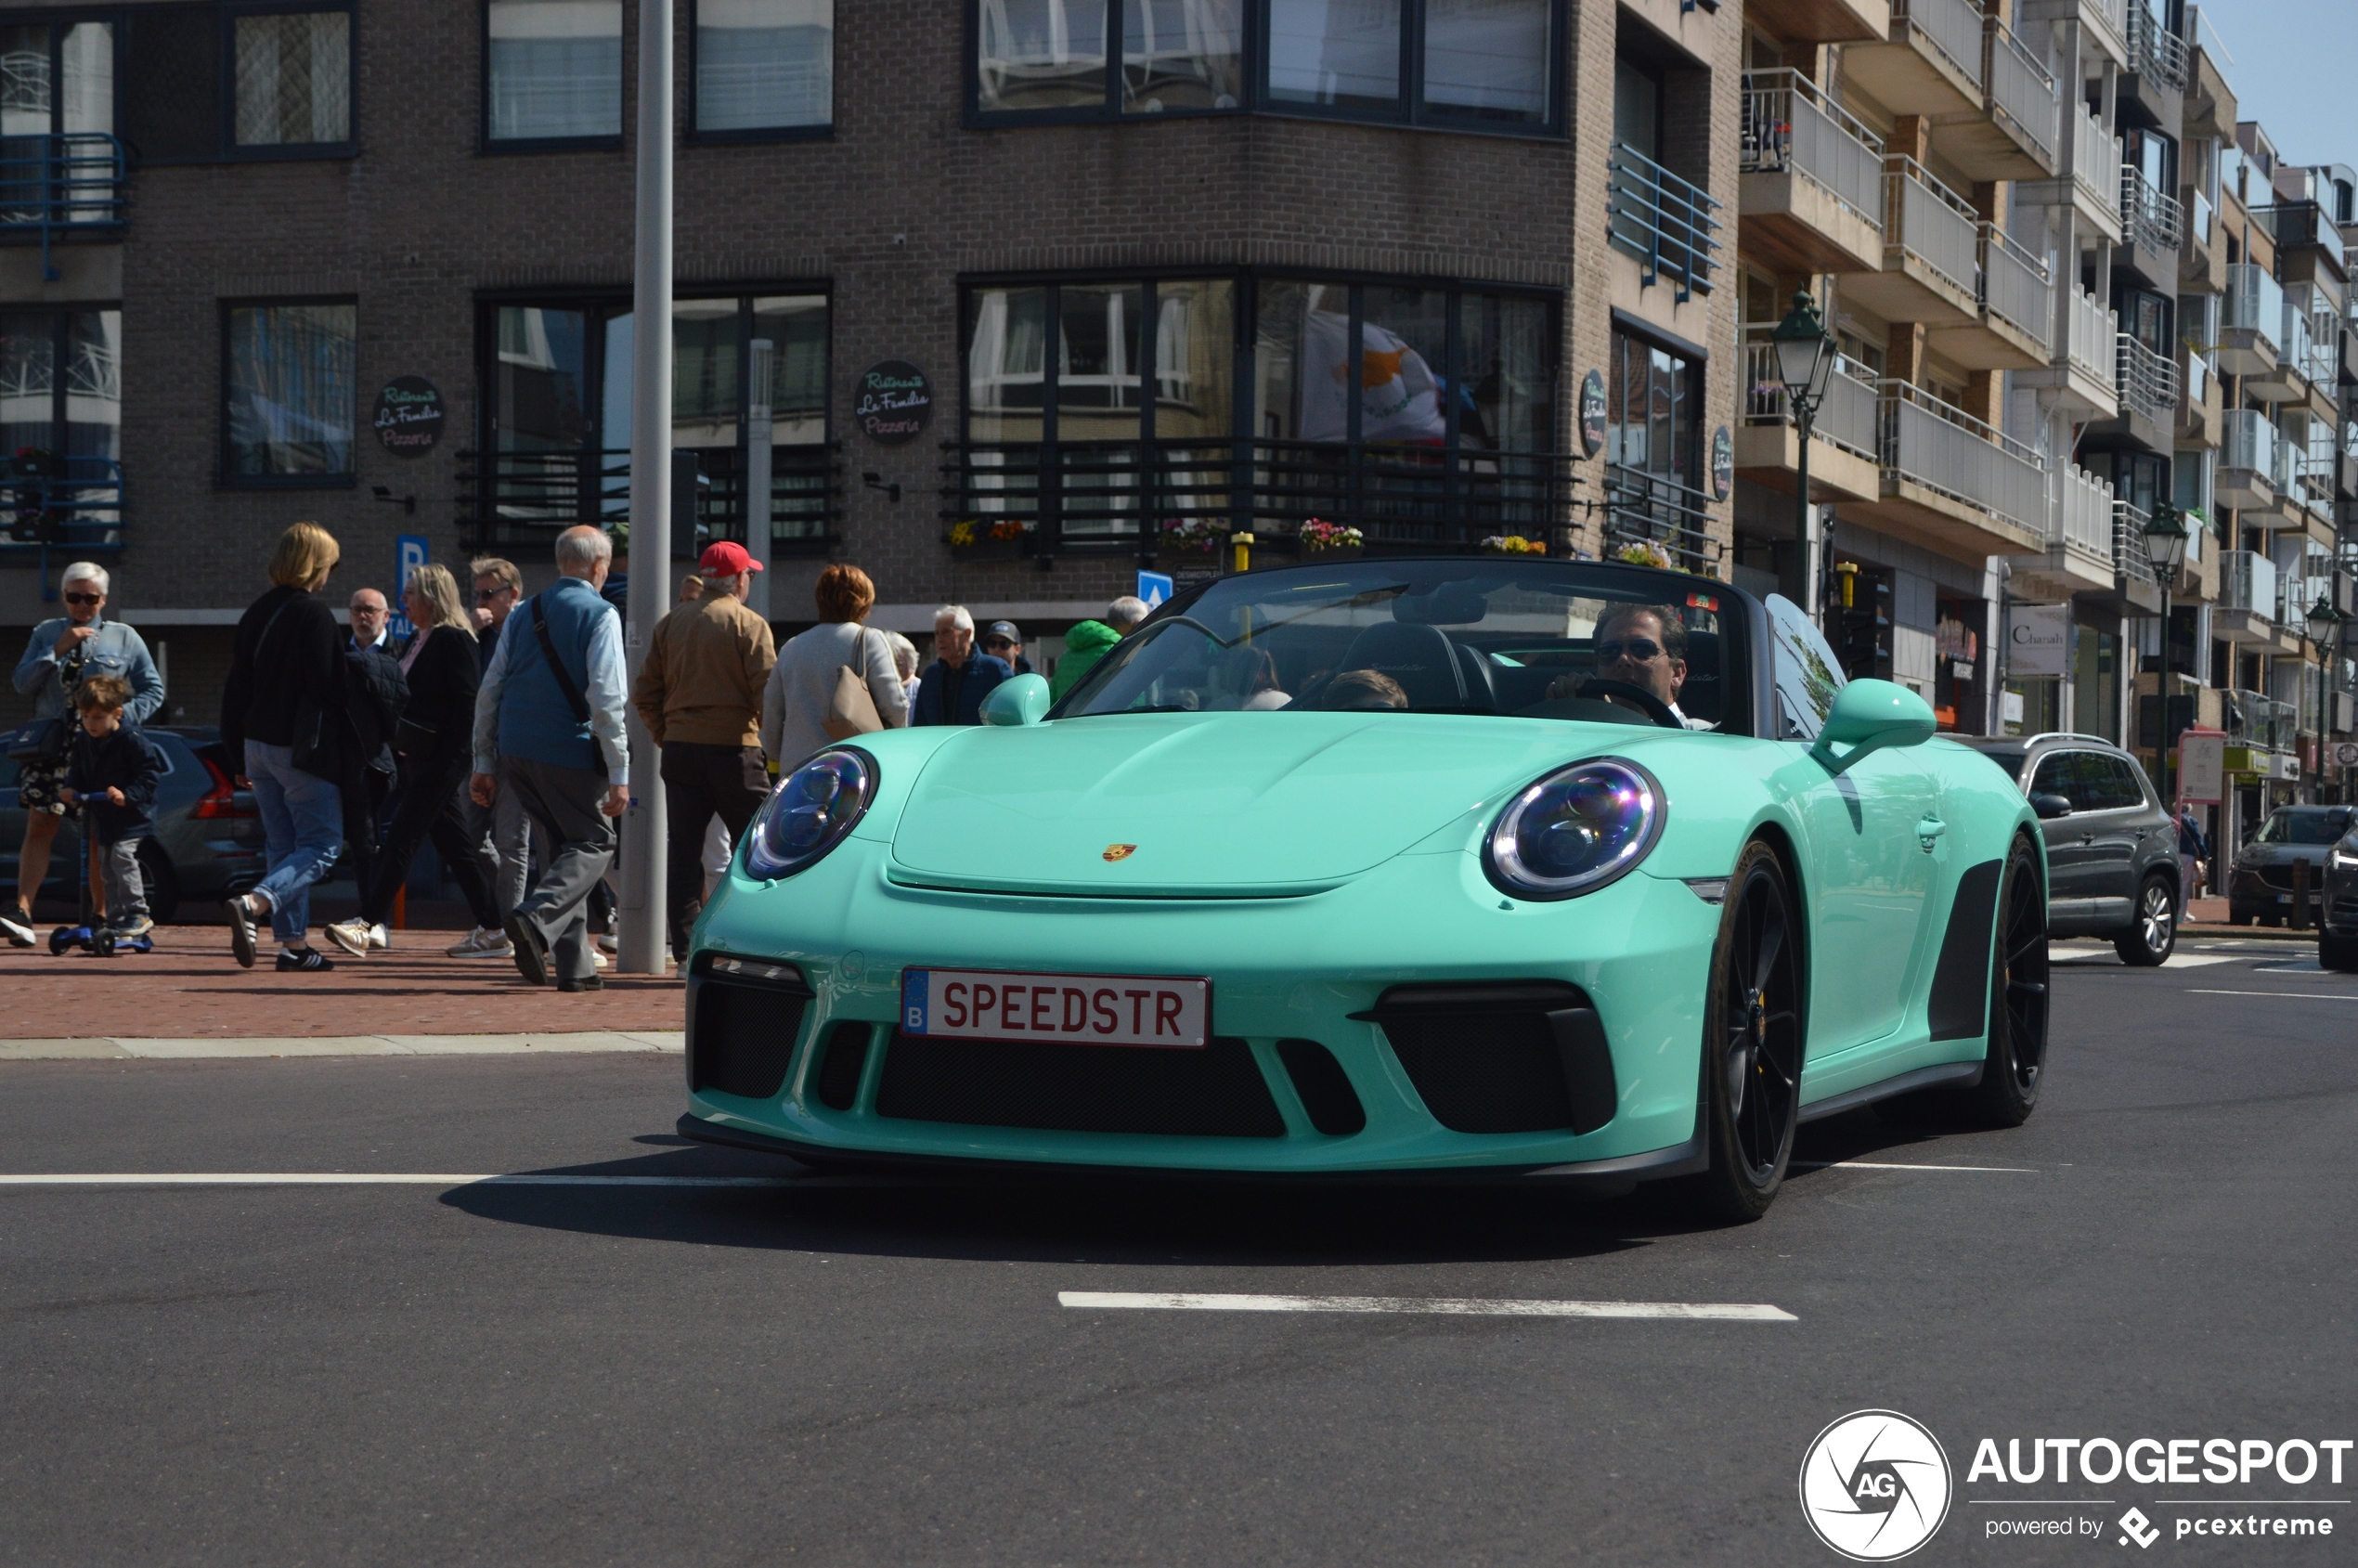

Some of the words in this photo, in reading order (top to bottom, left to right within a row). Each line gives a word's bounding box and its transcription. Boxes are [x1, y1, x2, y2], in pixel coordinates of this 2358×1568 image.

[857, 394, 880, 415] La
[879, 390, 929, 409] Familia
[374, 408, 396, 428] La
[865, 416, 919, 434] Pizzeria
[402, 541, 424, 590] P
[2013, 625, 2063, 644] Chanah
[907, 1006, 924, 1028] B
[943, 982, 1184, 1037] SPEEDSTR
